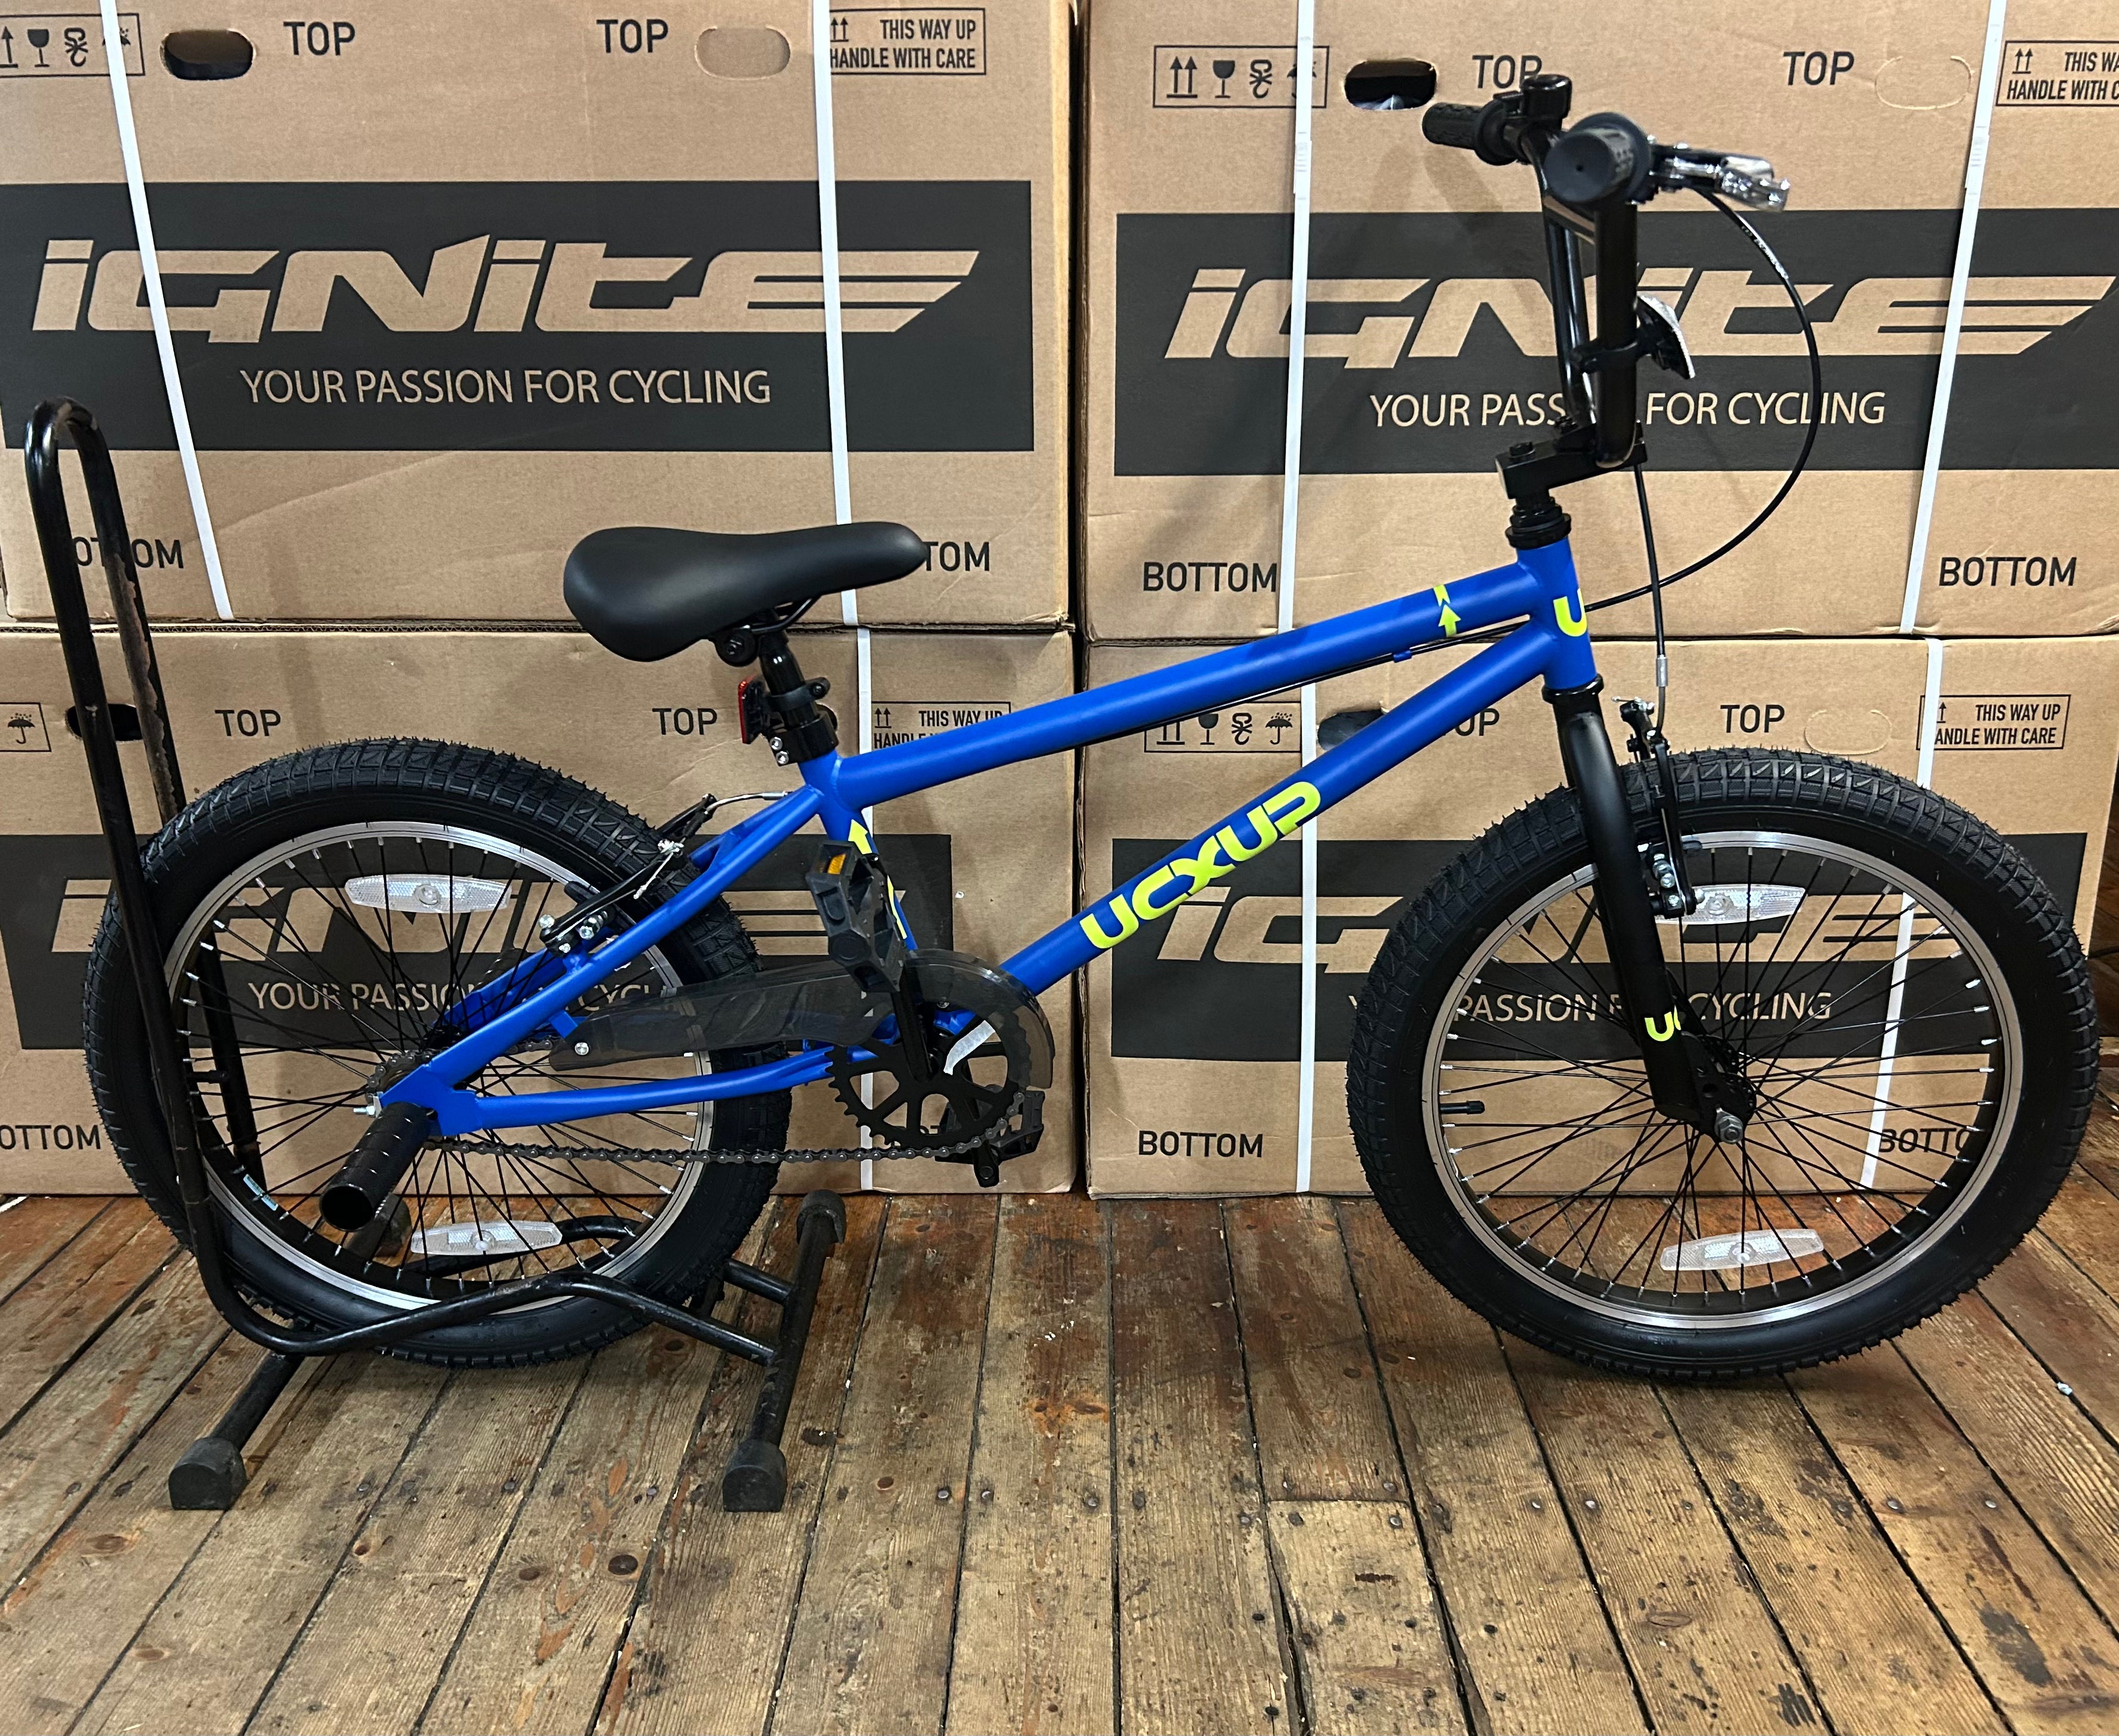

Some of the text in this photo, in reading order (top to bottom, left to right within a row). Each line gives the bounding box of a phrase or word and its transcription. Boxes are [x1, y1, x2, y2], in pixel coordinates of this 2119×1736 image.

[283, 21, 356, 56] TOP
[596, 18, 669, 54] TOP
[879, 19, 976, 40] THIS WAY UP
[830, 48, 976, 68] HANDLE WITH CARE
[1472, 54, 1542, 89] TOP
[1783, 51, 1855, 86] TOP
[2064, 51, 2098, 73] THIS
[2007, 79, 2068, 100] HANDLE
[2071, 79, 2108, 100] WITH
[240, 369, 771, 405] YOUR PASSION FOR CYCLING
[1370, 392, 1886, 427] YOUR PASS FOR CYCLING
[922, 540, 990, 571] TOM
[1143, 561, 1278, 593] BOTTOM
[1938, 556, 2077, 587] BOTTOM
[214, 710, 282, 737] TOP
[652, 707, 718, 736] TOP
[918, 710, 949, 727] THIS
[952, 710, 981, 727] WAY
[1455, 708, 1500, 737] OP
[1720, 704, 1785, 734] TOP
[1975, 704, 2061, 721] THIS WAY UP
[1934, 727, 2057, 745] ANDLE WITH CARE
[248, 982, 475, 1012] YOUR PASSIO
[1452, 993, 1599, 1023] PASSION
[1688, 992, 1832, 1021] CYCLING
[0, 1124, 101, 1150] OTTOM
[1137, 1130, 1264, 1159] BOTTOM
[1878, 1127, 1971, 1153] BOTTO
